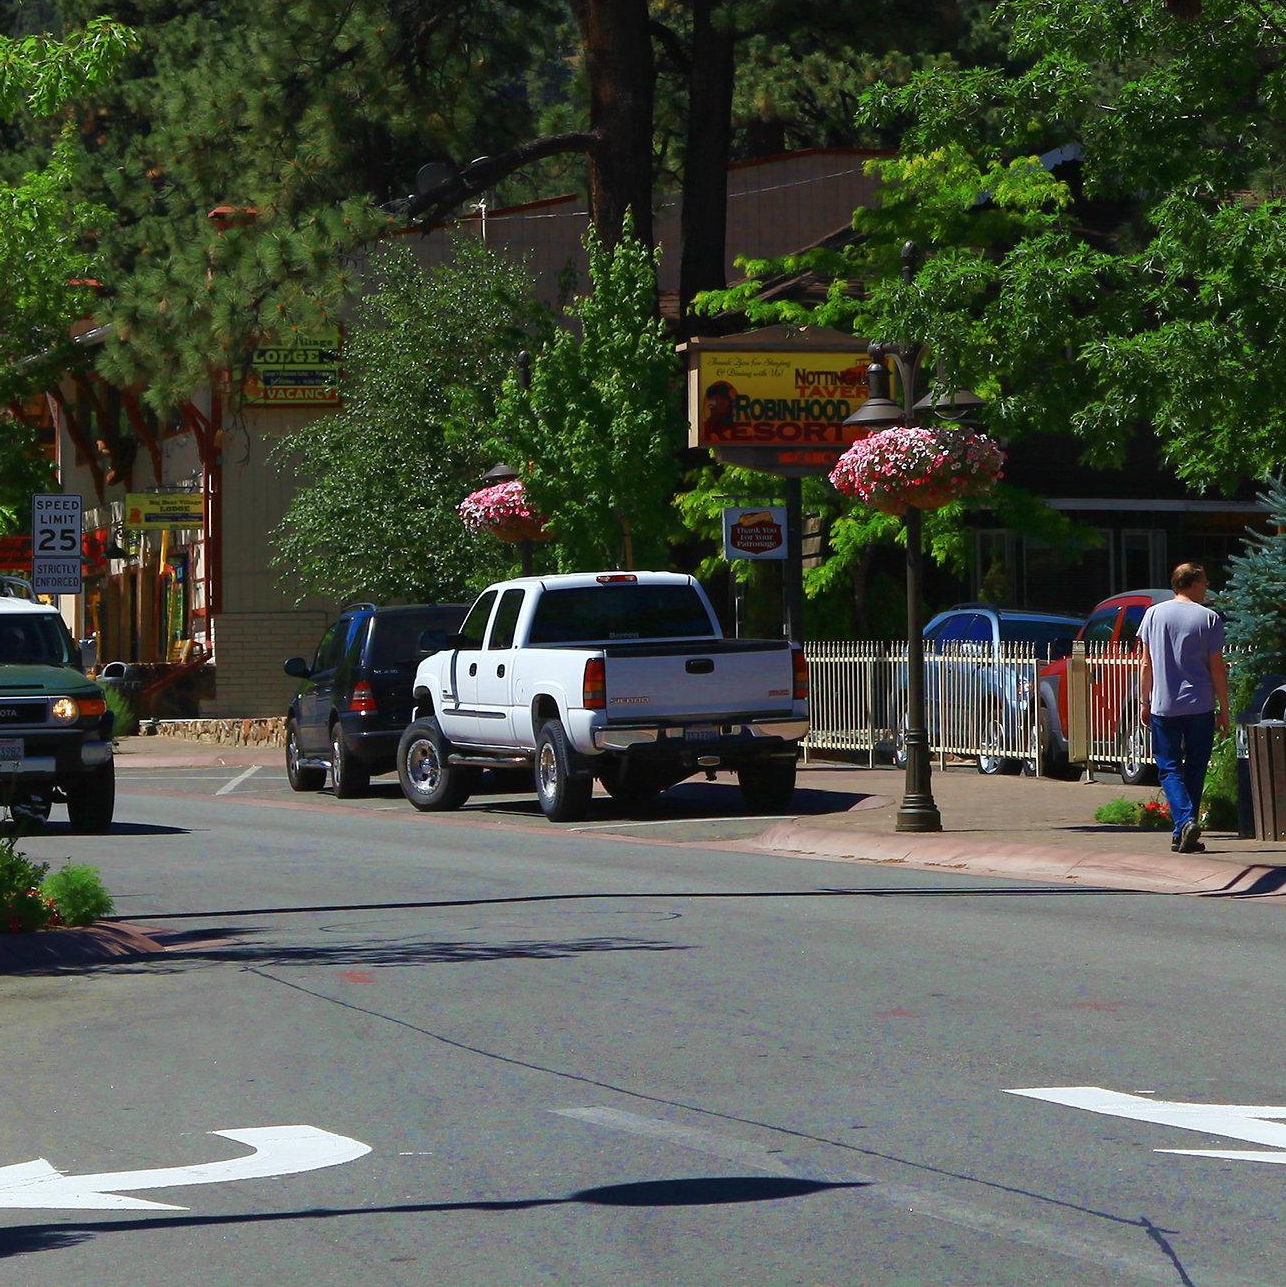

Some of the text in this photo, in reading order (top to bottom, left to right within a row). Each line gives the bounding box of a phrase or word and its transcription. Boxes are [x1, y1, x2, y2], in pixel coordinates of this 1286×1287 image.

[253, 349, 320, 363] LODGE
[795, 386, 869, 399] TAVER
[735, 394, 850, 422] ROBINHOOD
[704, 421, 844, 442] RESORT
[36, 500, 80, 510] SPEED
[40, 514, 75, 524] LIMIT
[38, 528, 77, 551] 25
[37, 564, 77, 574] STRICTLY
[35, 577, 79, 587] ENFORCED
